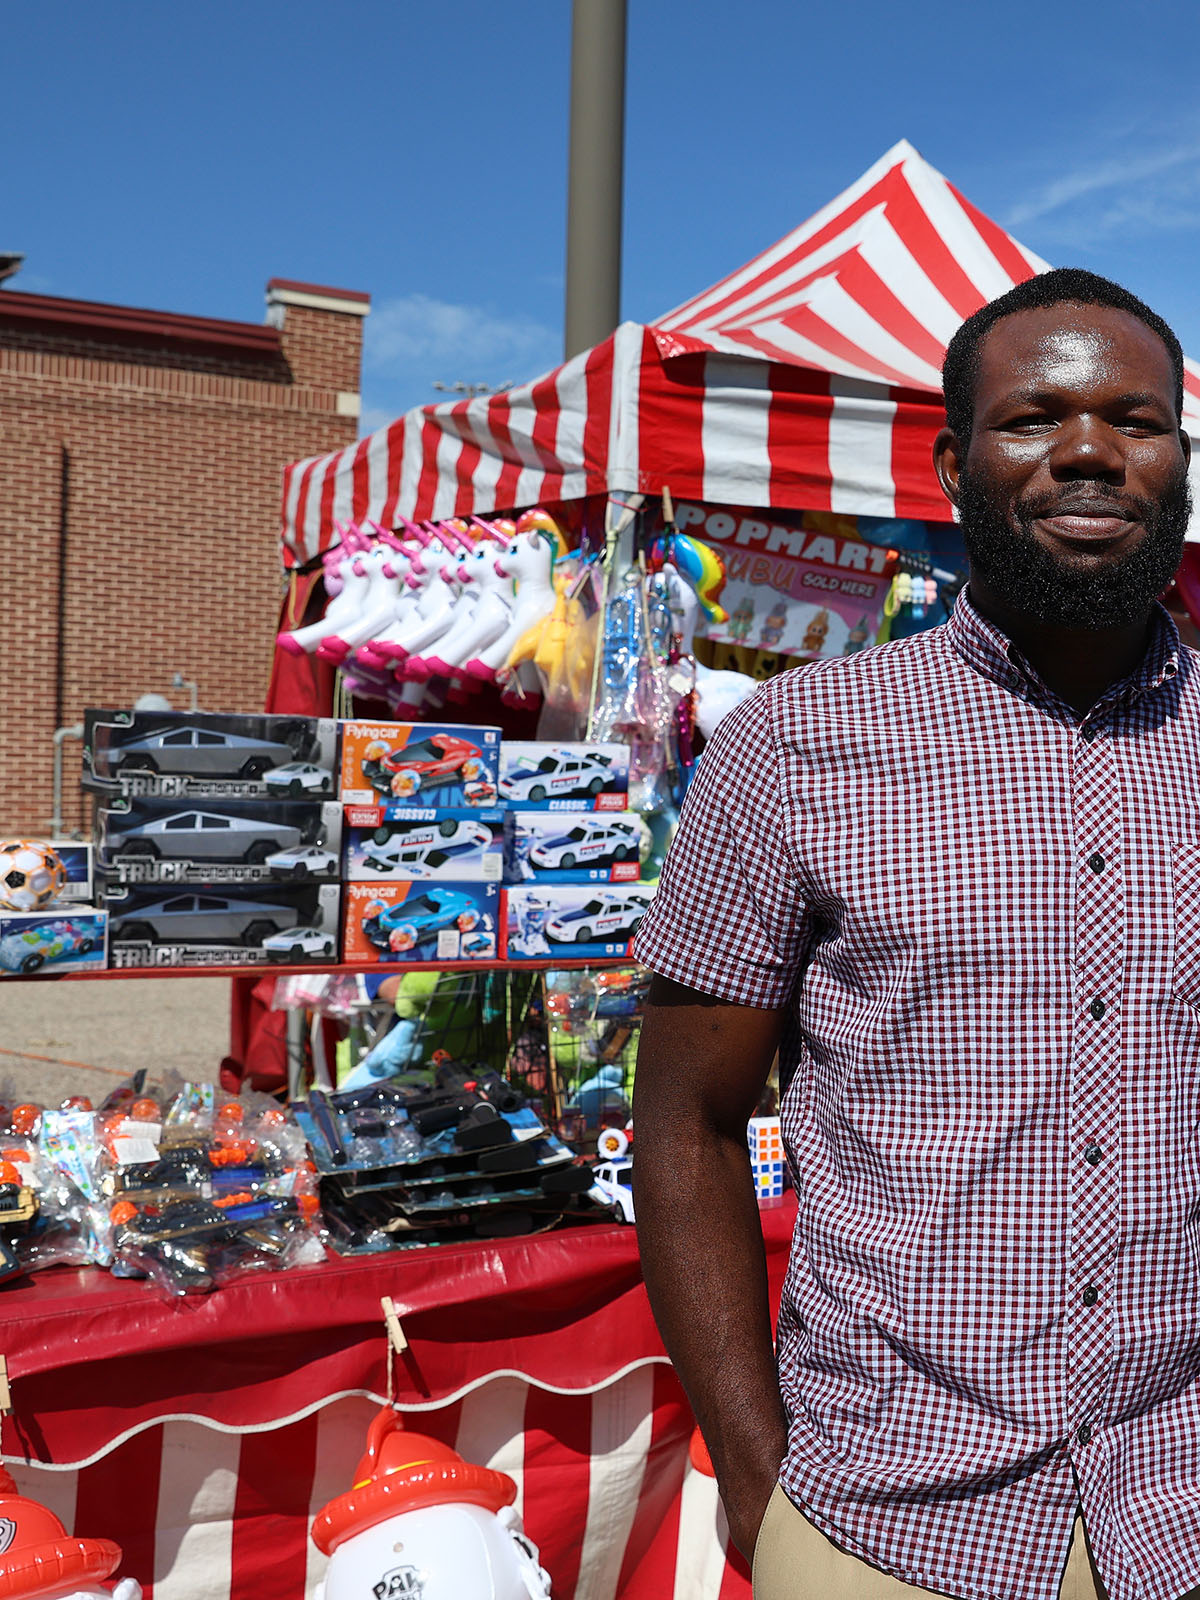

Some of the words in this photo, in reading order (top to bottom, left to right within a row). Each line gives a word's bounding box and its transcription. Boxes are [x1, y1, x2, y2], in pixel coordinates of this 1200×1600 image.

[675, 503, 888, 574] POPMART
[803, 572, 839, 590] SOLD
[841, 580, 876, 598] HERE
[119, 777, 189, 797] TRUCK
[116, 862, 190, 883] TRUCK
[113, 946, 187, 967] TRUCK
